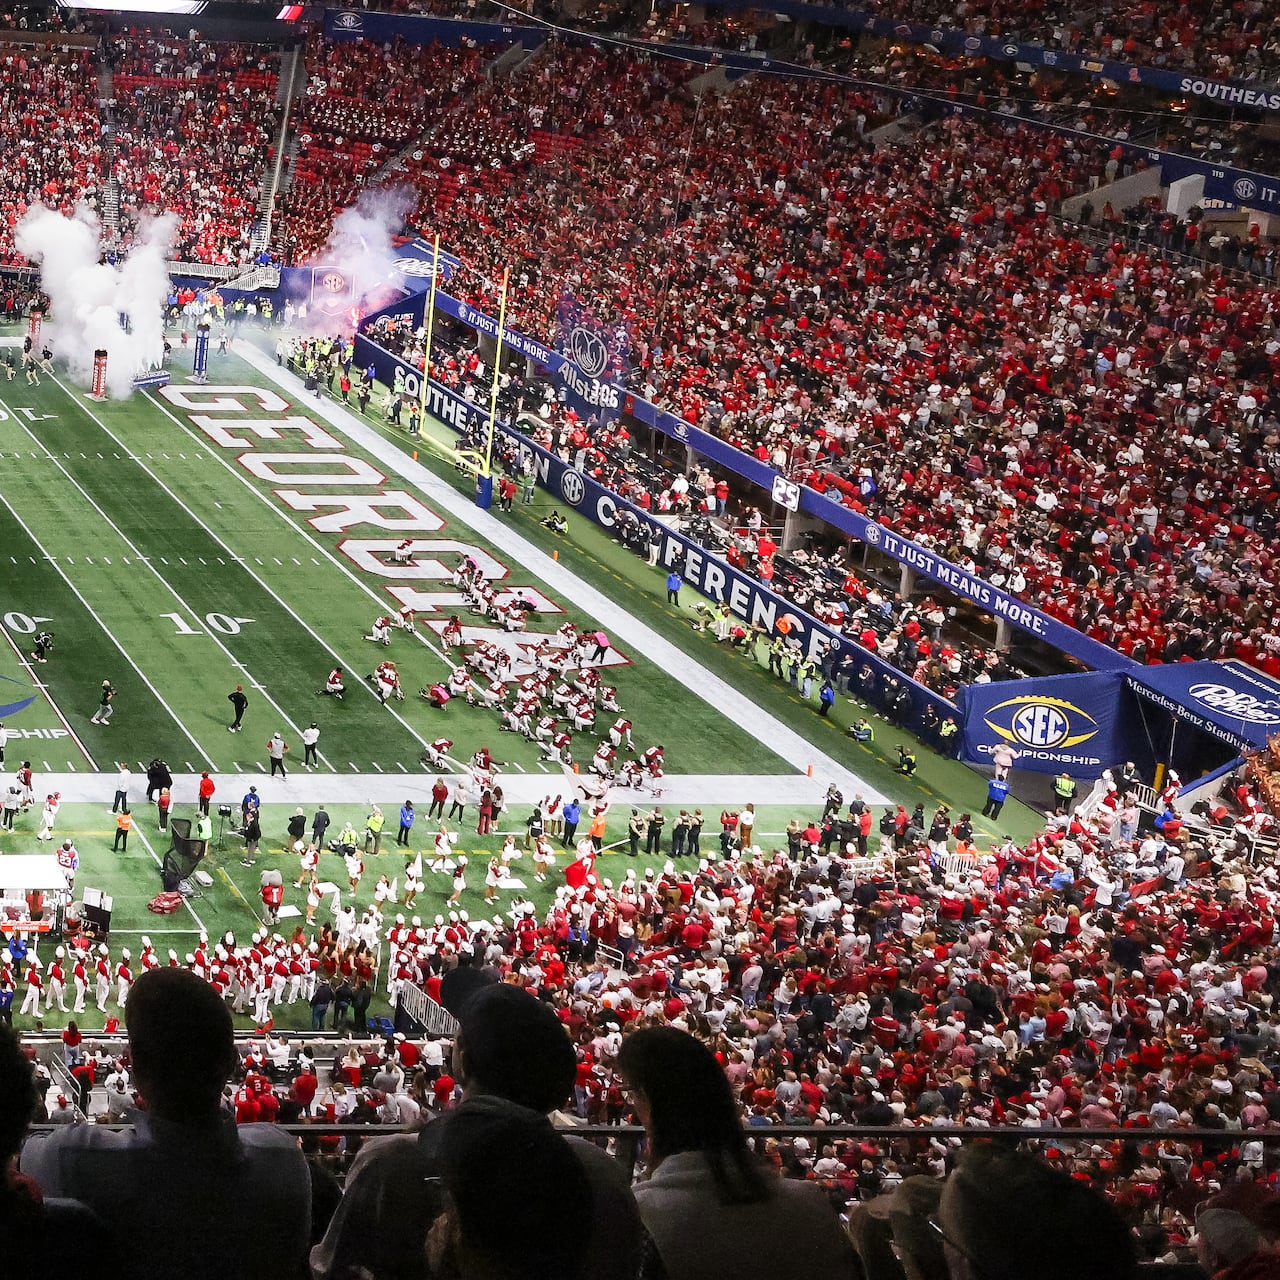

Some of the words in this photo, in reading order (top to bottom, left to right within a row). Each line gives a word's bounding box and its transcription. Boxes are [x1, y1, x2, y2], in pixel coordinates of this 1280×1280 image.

[476, 315, 494, 332] JUST
[882, 534, 898, 552] IT
[898, 542, 934, 575] JUST
[936, 562, 991, 605] MEANS
[159, 612, 241, 635] 10
[1127, 676, 1203, 726] Mercedes-Benz
[1013, 704, 1066, 745] SEC
